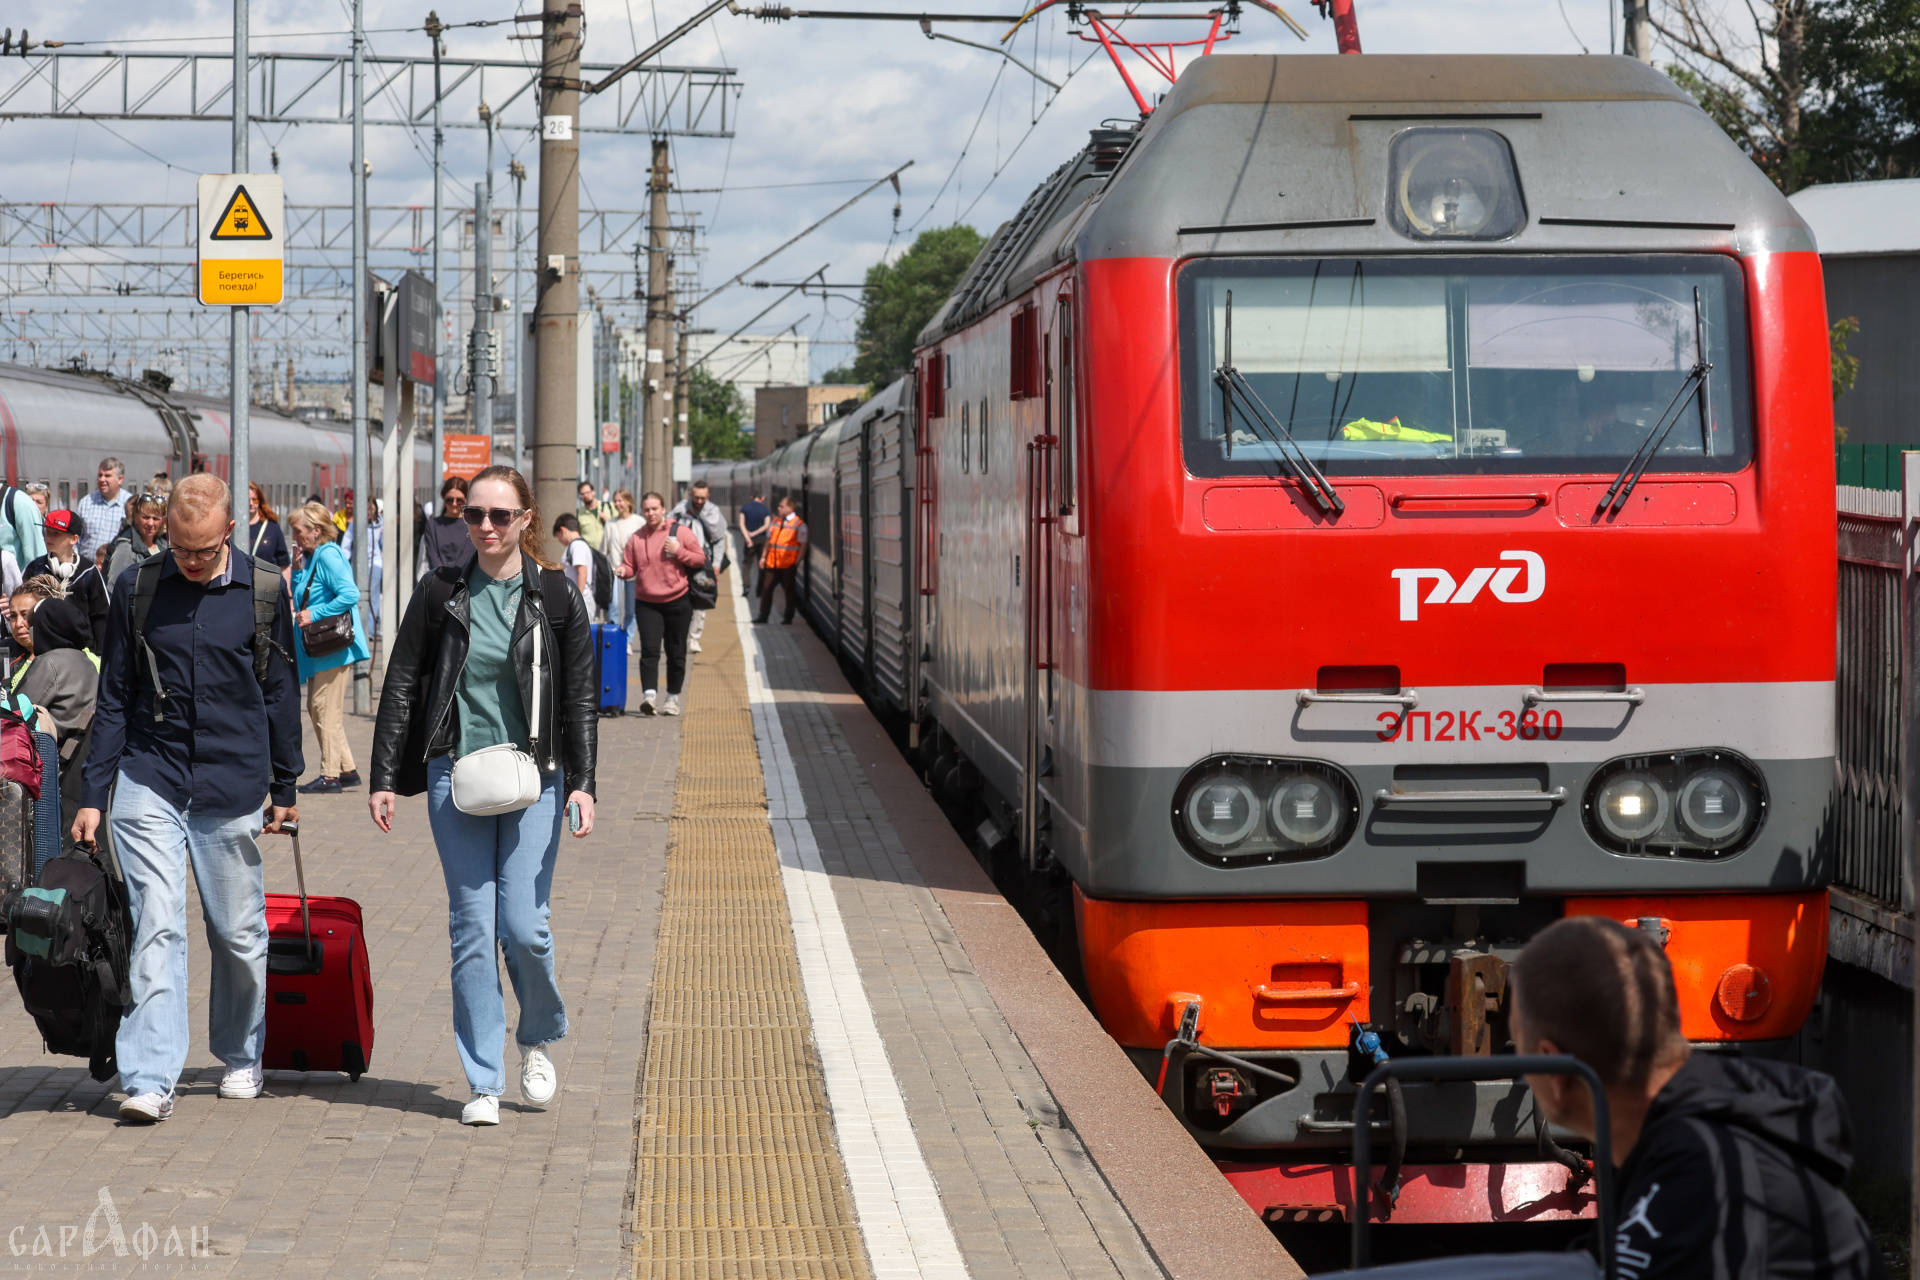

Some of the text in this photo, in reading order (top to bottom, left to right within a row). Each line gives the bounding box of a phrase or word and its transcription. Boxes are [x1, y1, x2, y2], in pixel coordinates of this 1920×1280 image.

[549, 121, 565, 134] 26
[219, 271, 264, 281] Берегись
[219, 282, 257, 291] поезда!
[1376, 709, 1563, 742] ЭП2К-380
